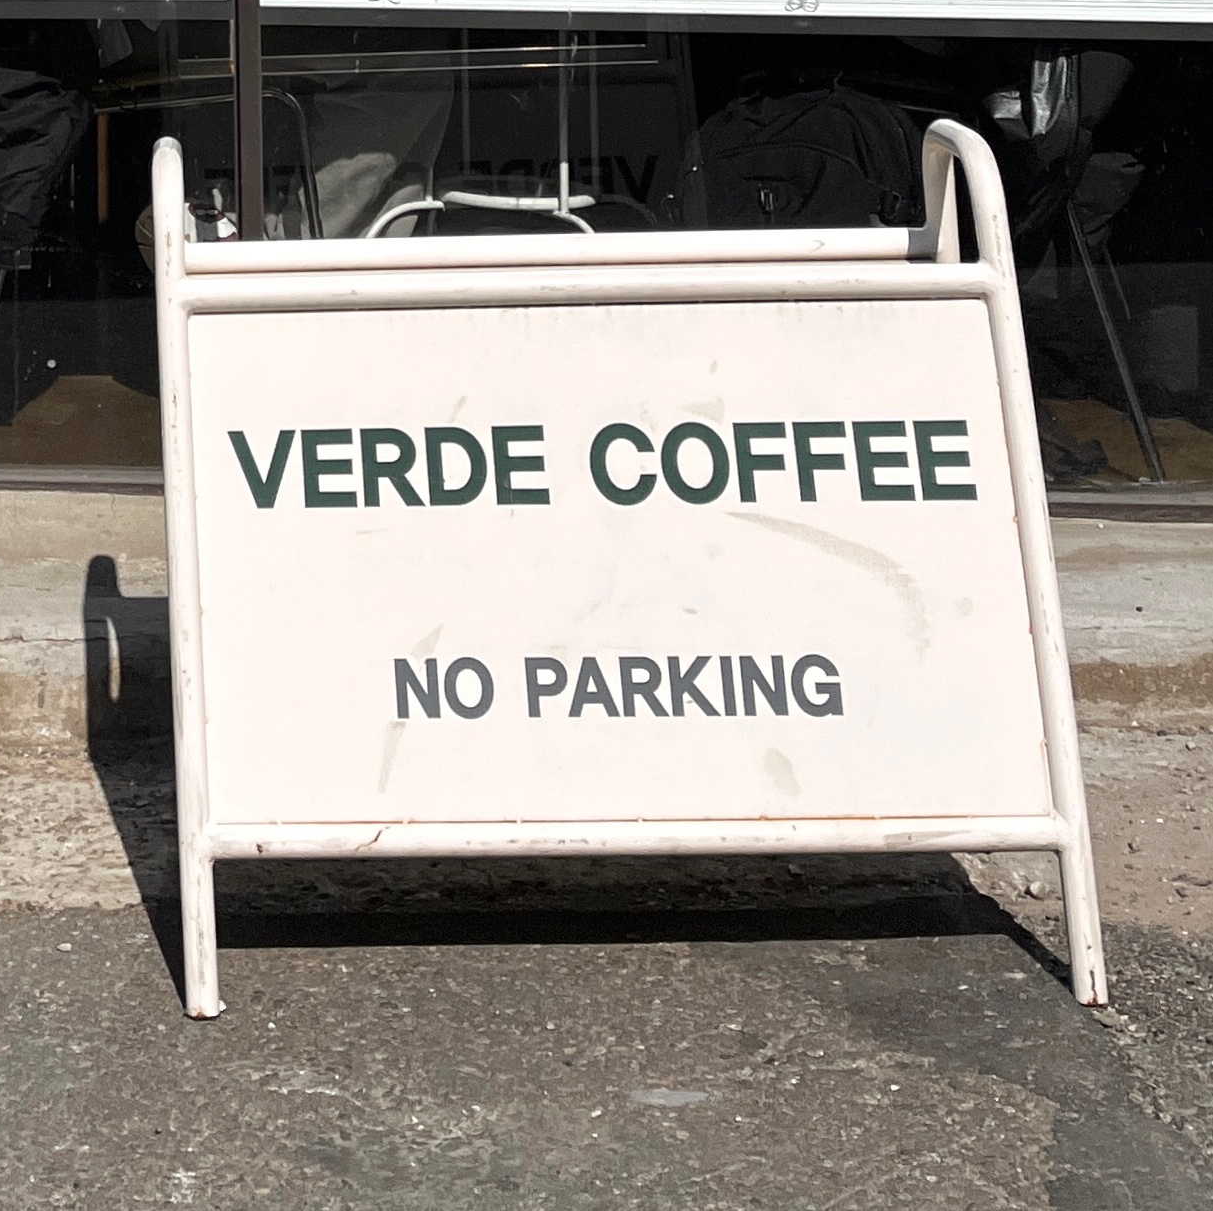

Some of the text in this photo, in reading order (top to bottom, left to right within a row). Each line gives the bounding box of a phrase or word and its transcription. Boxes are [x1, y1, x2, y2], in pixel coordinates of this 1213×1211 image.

[228, 419, 978, 509] VERDE COFFEE
[394, 654, 844, 720] NO PARKING
